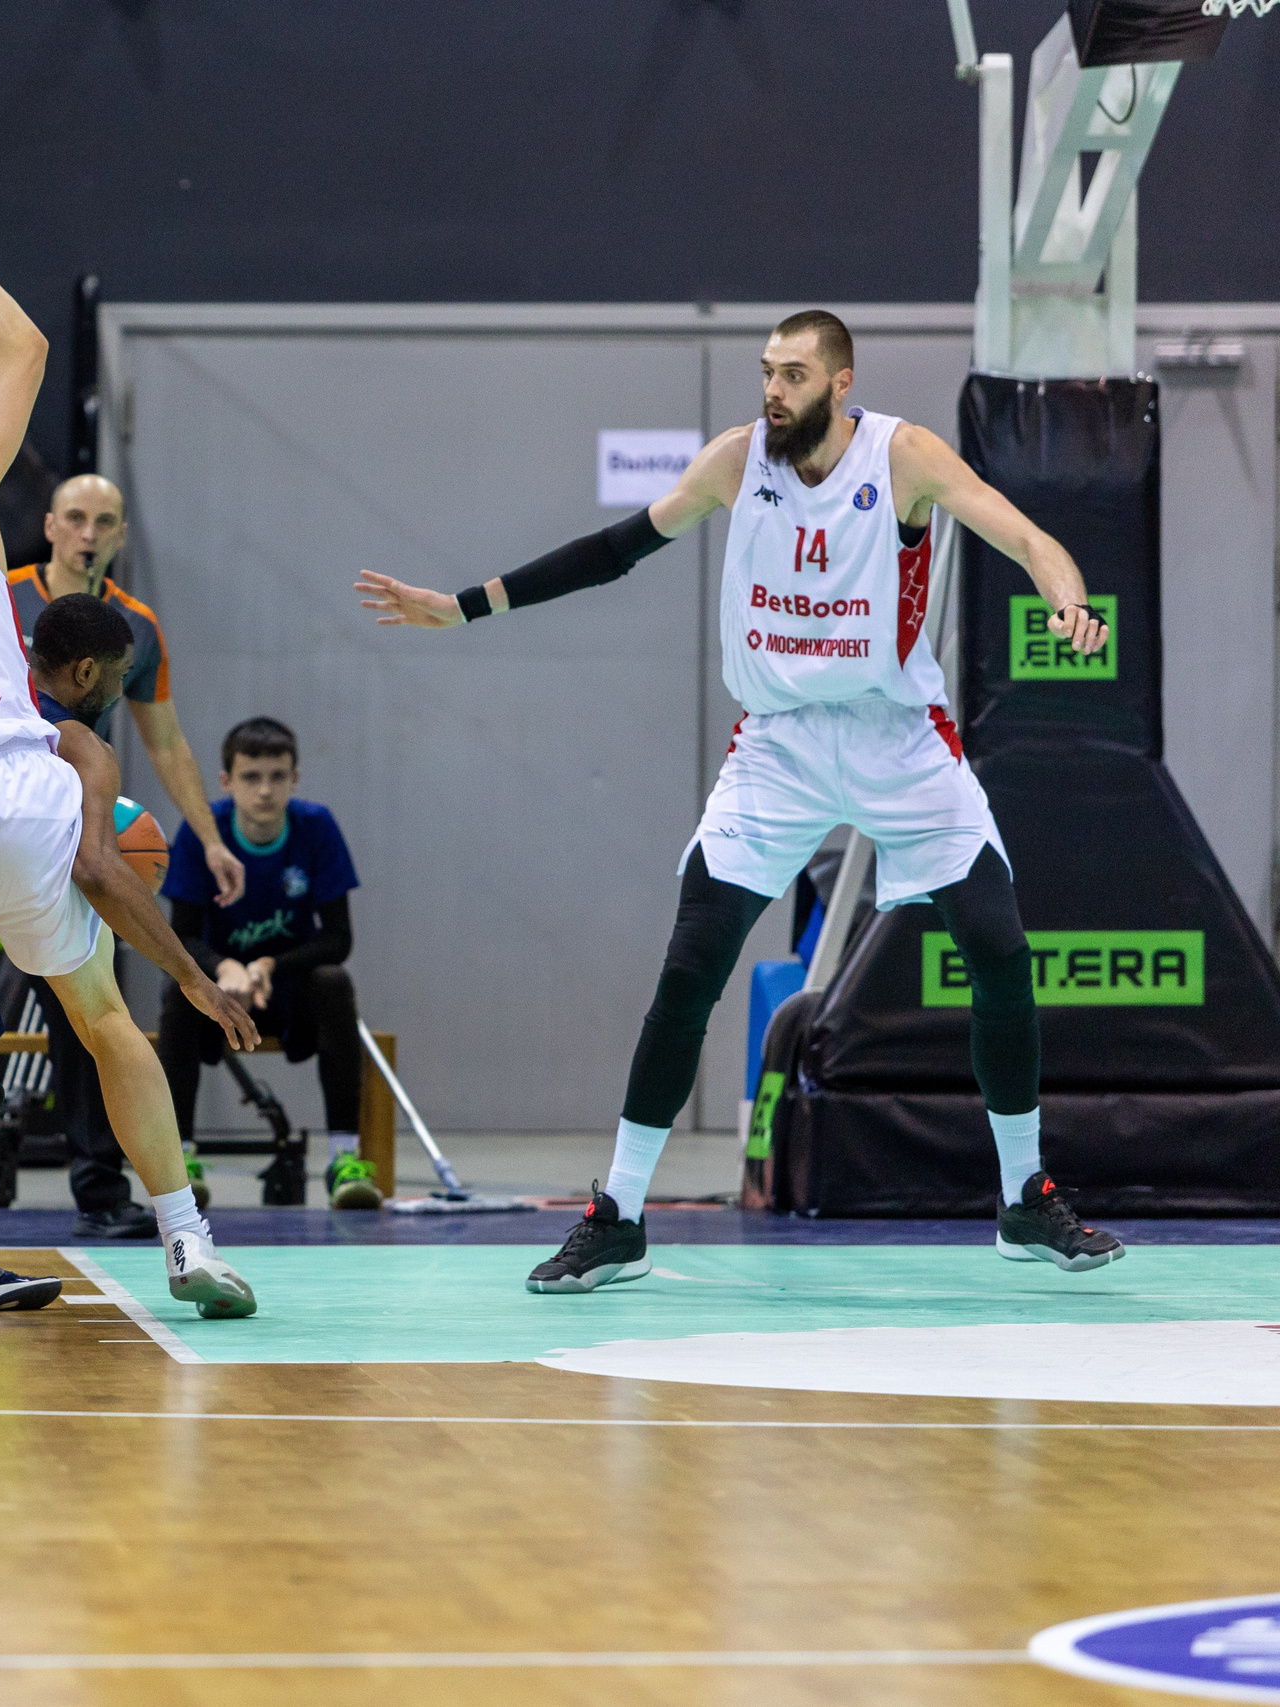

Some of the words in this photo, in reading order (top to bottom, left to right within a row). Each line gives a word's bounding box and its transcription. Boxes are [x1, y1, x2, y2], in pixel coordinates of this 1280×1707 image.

[795, 525, 829, 572] 14
[750, 583, 870, 618] BetBoom
[765, 633, 871, 658] МОСИНЖПРОЕКТ
[939, 949, 1187, 988] BT.ERA
